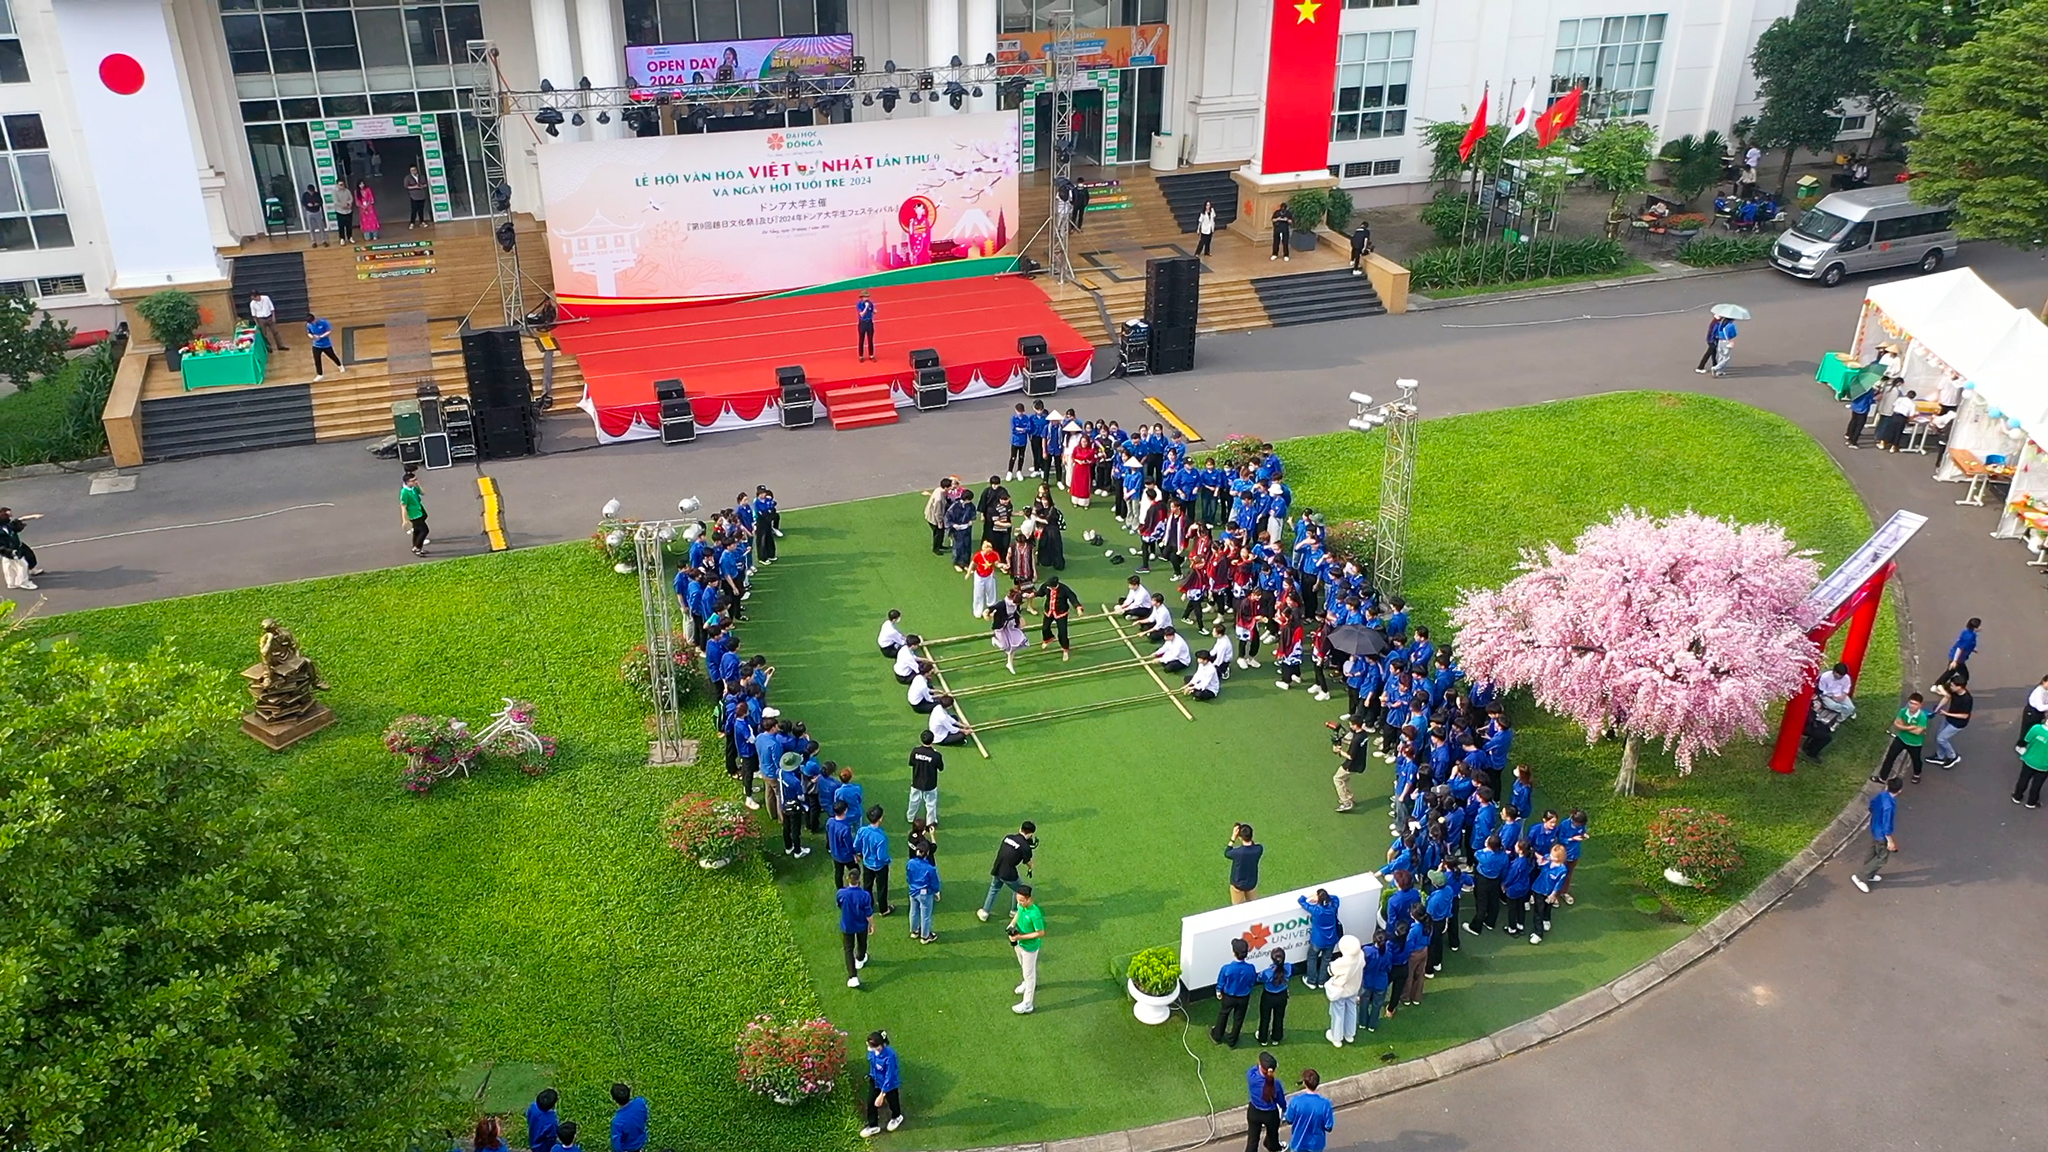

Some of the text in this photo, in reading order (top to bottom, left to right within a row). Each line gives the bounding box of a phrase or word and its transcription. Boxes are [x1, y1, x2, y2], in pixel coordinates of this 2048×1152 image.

[646, 57, 717, 73] OPEN DAY
[649, 74, 684, 86] 2024
[654, 173, 679, 187] HỘI
[748, 161, 791, 181] VIỆT
[822, 154, 874, 174] NHẬT
[933, 153, 940, 163] 9
[732, 182, 766, 196] NGÀY
[770, 181, 792, 194] HỘI
[795, 177, 822, 191] TUỔI
[850, 176, 872, 186] 2024
[759, 197, 827, 212] ドンア大学主催
[1273, 914, 1313, 934] DON
[1271, 927, 1312, 944] UNIVER
